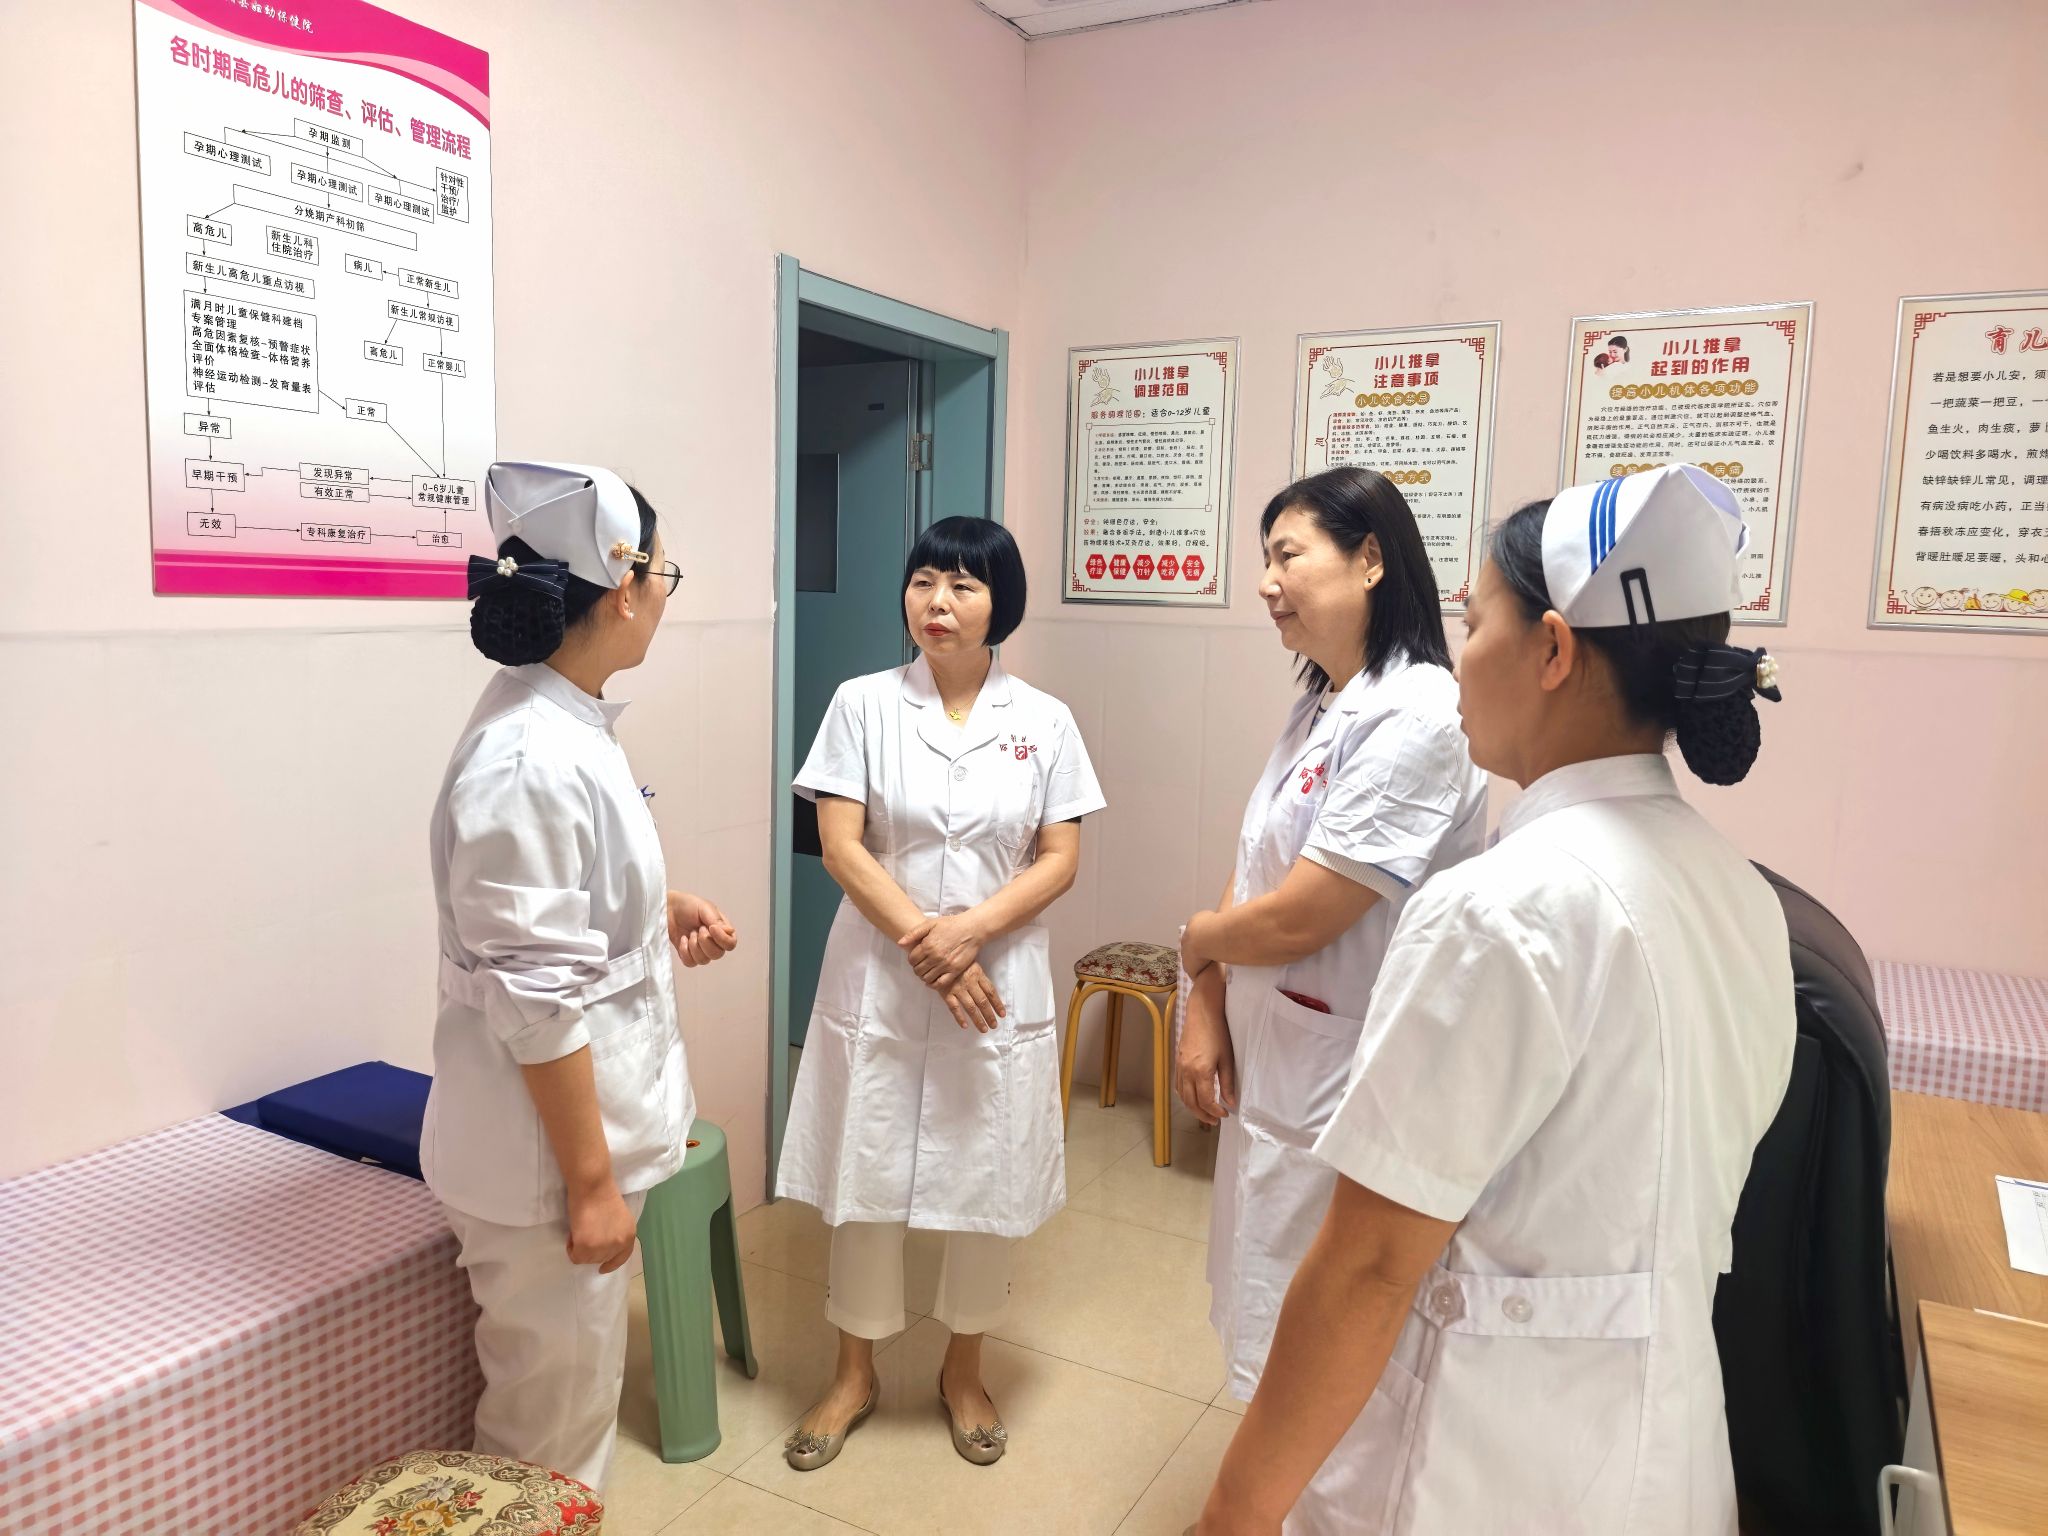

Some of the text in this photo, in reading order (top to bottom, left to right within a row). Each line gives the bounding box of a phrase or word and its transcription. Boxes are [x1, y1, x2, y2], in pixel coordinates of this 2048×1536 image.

[170, 35, 473, 161] 各时期高危儿的筛查、评估、管理流程
[308, 127, 351, 150] 孕期监测
[194, 140, 263, 169] 孕期心理测试
[297, 170, 358, 196] 孕期心理测试
[441, 172, 464, 188] 针对性
[375, 193, 430, 218] 孕期心理测试
[441, 204, 457, 216] 监护
[295, 204, 366, 233] 分娩期产科初筛
[193, 222, 227, 239] 高危儿
[271, 230, 314, 249] 新生儿科
[271, 242, 314, 260] 住院治疗
[353, 260, 373, 273] 病儿
[193, 260, 305, 293] 新生儿高危儿重点访视
[407, 274, 451, 293] 正常新生儿
[191, 298, 303, 328] 满月时儿童保健科建档
[391, 304, 454, 326] 新生儿常规访视
[191, 312, 237, 329] 专案管理
[370, 346, 397, 360] 高危儿
[1663, 337, 1741, 356] 小儿推拿
[192, 353, 214, 366] 评价
[428, 359, 462, 373] 正常婴儿
[1374, 352, 1440, 370] 小儿推拿
[1134, 365, 1189, 381] 小儿推拿
[1651, 357, 1750, 377] 起到的作用
[193, 380, 216, 393] 评估
[1373, 371, 1439, 389] 注意事项
[1134, 383, 1189, 398] 调理范围
[1611, 381, 1757, 398] 提高小儿机体各项功能
[1357, 393, 1429, 407] 小儿饮食禁忌
[357, 405, 375, 417] 正常
[198, 421, 221, 434] 异常
[192, 469, 238, 483] 早期干预
[313, 467, 352, 480] 发现异常
[314, 487, 354, 499] 有效正常
[422, 483, 464, 496] 0-6岁儿童
[418, 492, 470, 505] 常规健康管理
[200, 519, 222, 530] 无效
[307, 527, 366, 540] 专科康复治疗
[432, 534, 450, 544] 治愈
[1137, 559, 1151, 567] 减少
[1161, 559, 1176, 567] 减少
[1186, 560, 1200, 568] 安全
[1089, 567, 1103, 575] 疗法
[1137, 568, 1151, 576] 打针
[1161, 568, 1175, 576] 吃药
